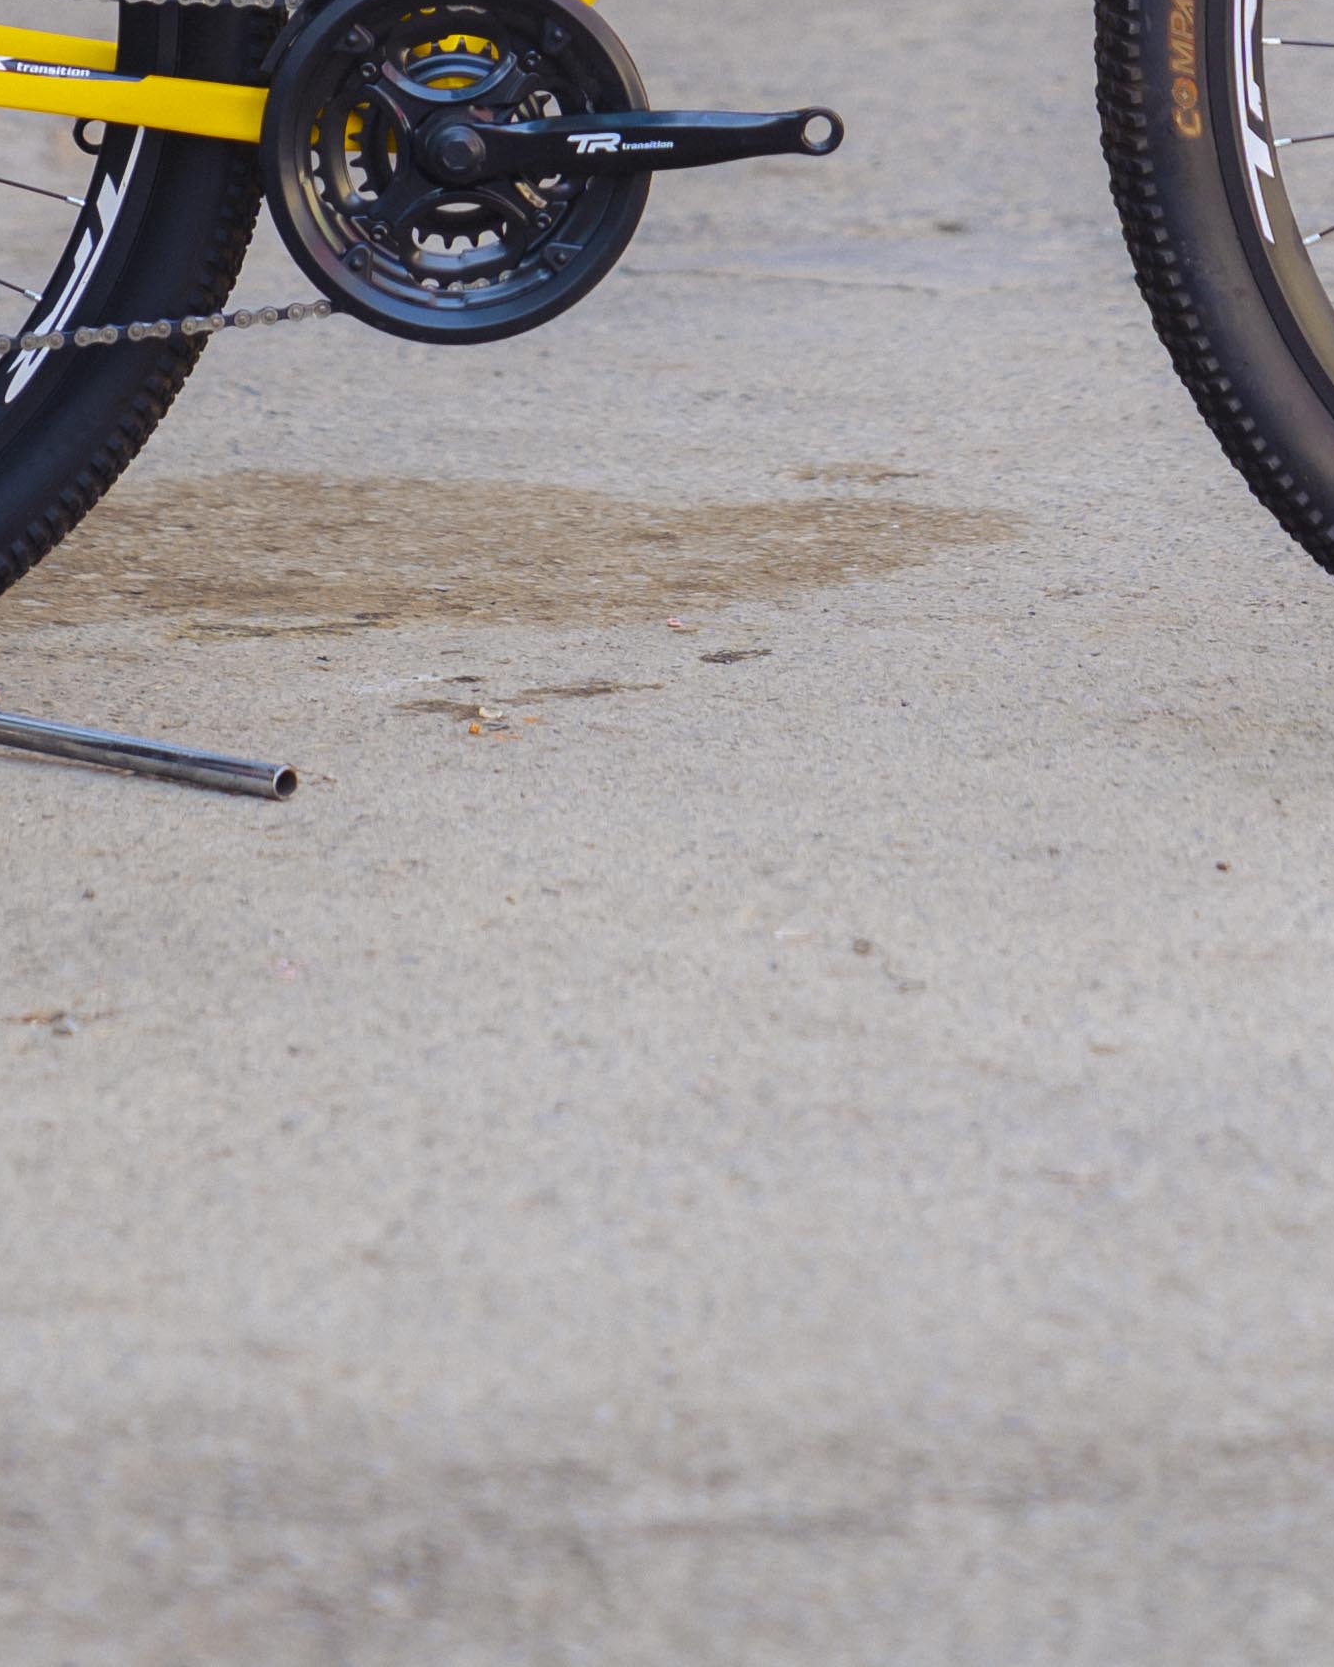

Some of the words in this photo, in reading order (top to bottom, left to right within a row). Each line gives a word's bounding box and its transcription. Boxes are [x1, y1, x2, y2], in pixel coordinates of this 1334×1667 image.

[16, 60, 91, 78] transition
[567, 132, 621, 154] TR
[622, 139, 674, 151] transition
